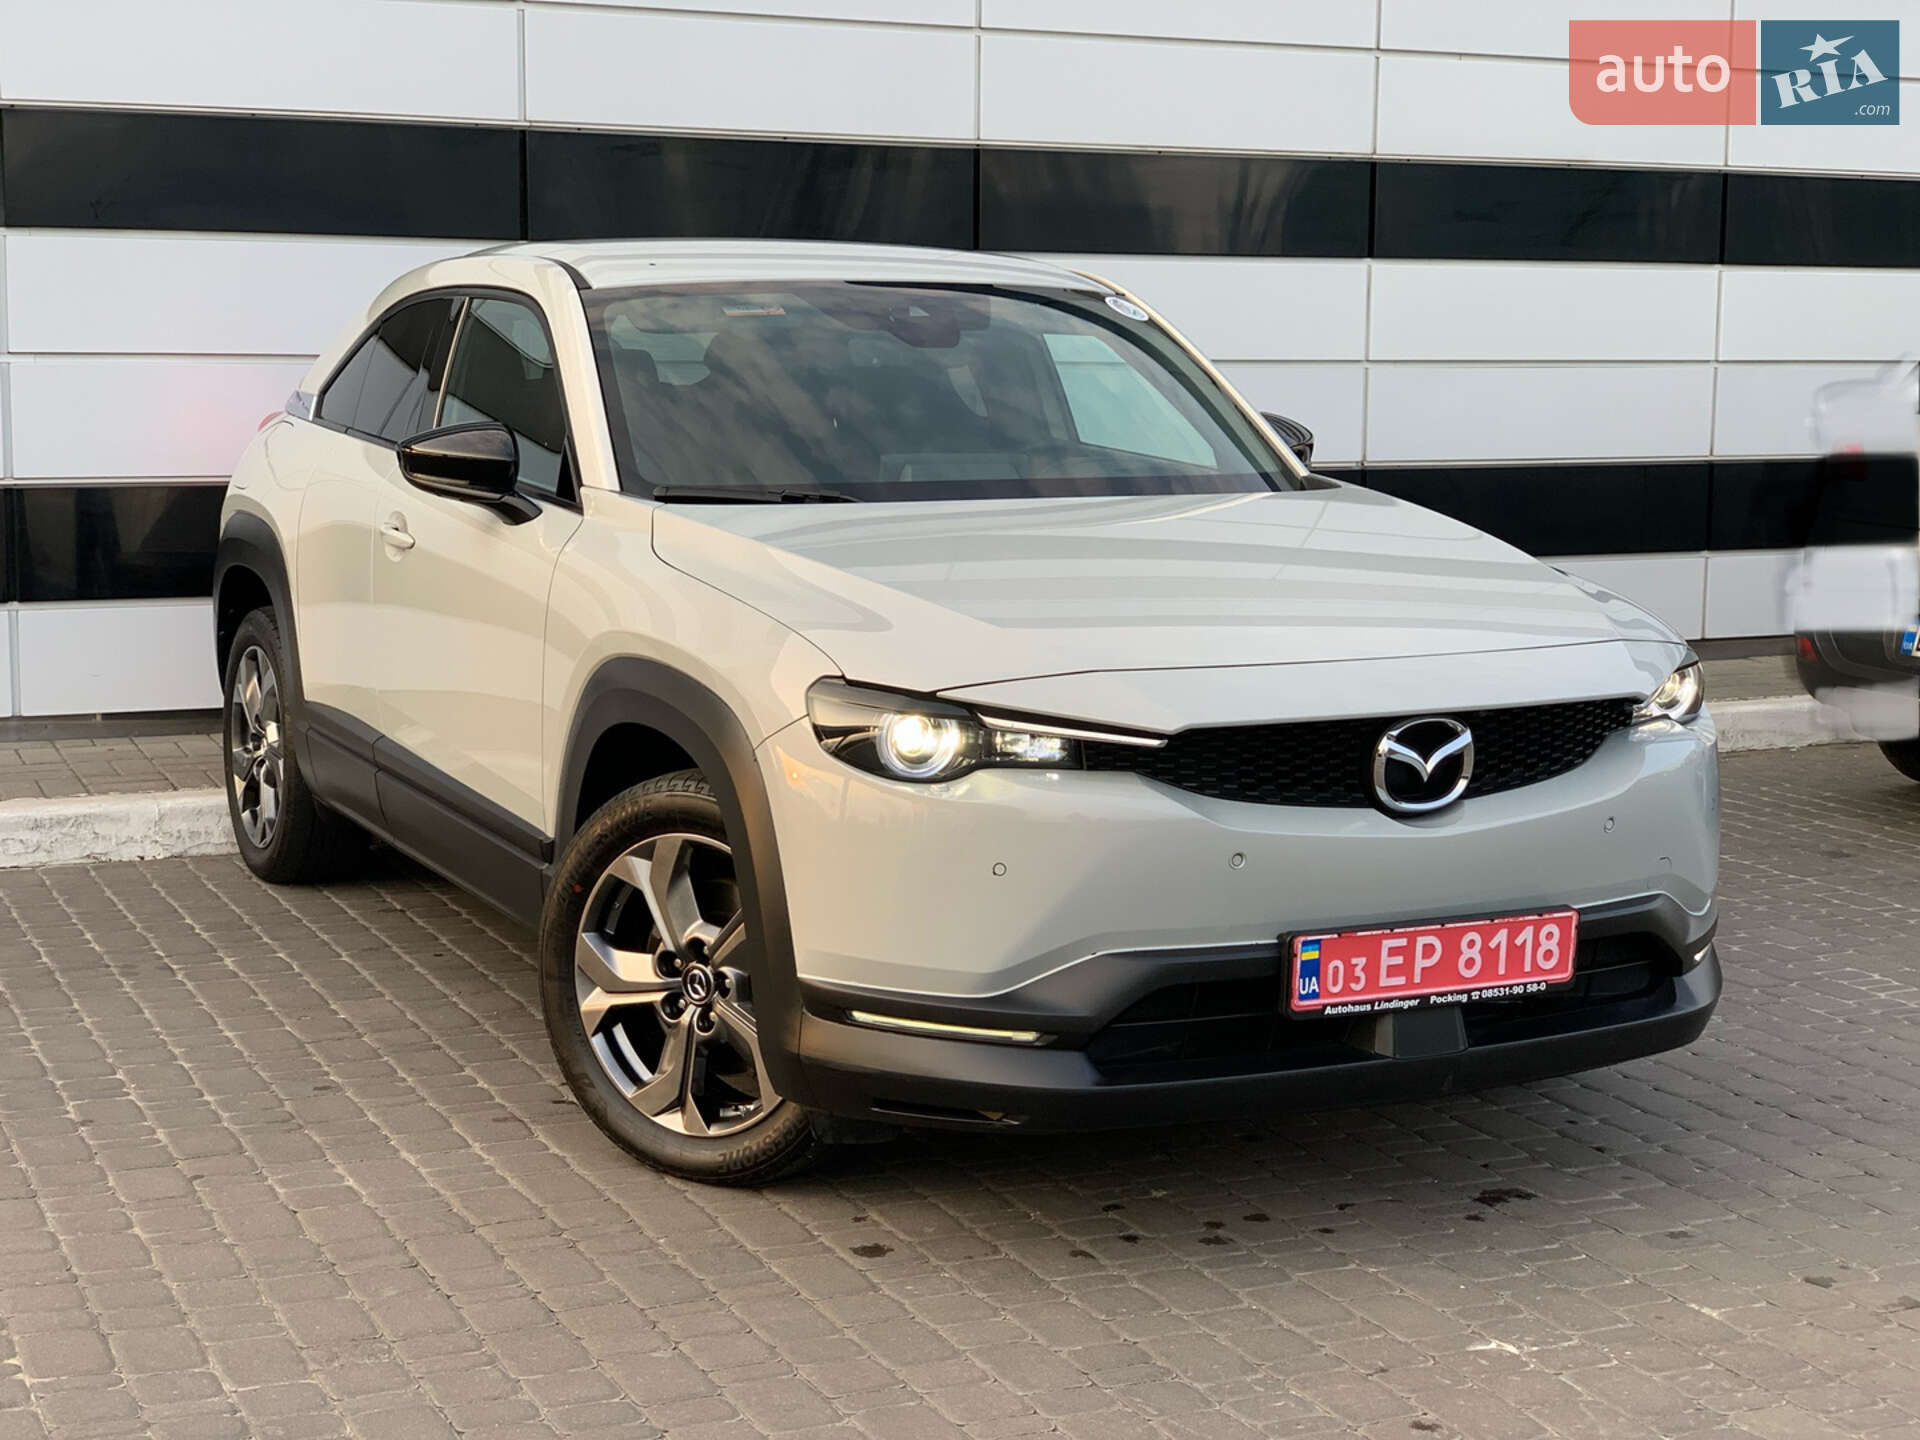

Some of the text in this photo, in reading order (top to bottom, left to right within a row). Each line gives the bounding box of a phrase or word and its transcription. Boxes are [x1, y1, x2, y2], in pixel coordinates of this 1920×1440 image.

[1326, 923, 1561, 994] 03 EP 8118
[1299, 976, 1320, 995] UA
[1324, 1003, 1372, 1015] Autohaus
[1374, 998, 1420, 1009] Lindinger
[1430, 993, 1468, 1004] Pocking
